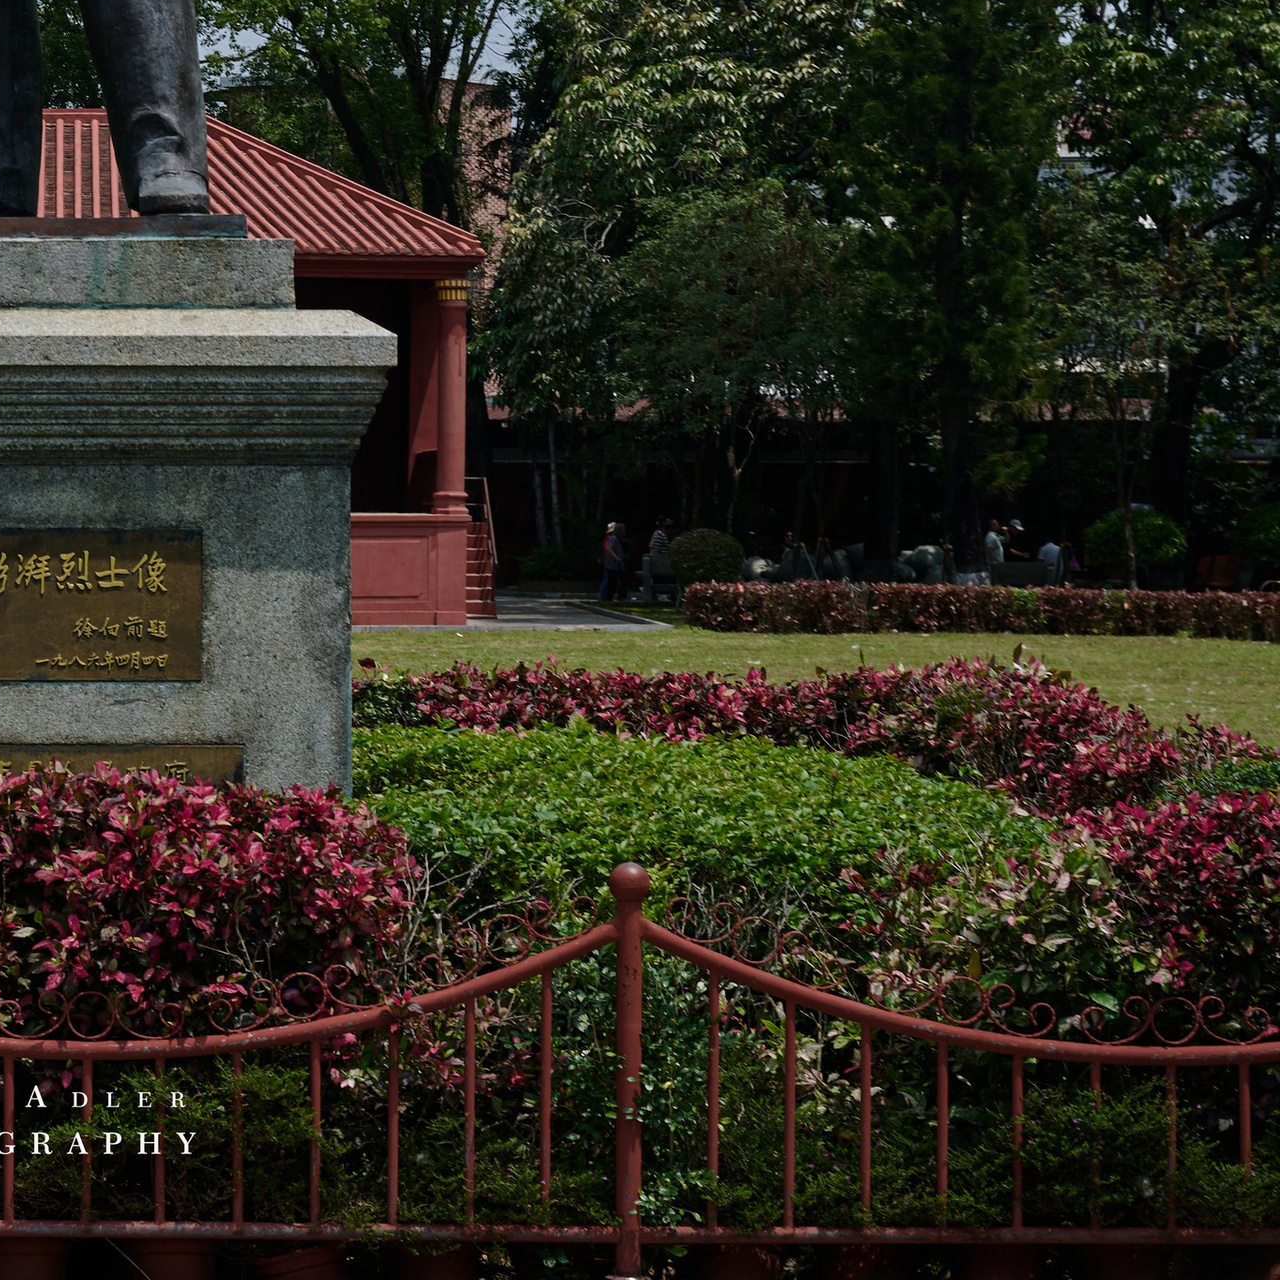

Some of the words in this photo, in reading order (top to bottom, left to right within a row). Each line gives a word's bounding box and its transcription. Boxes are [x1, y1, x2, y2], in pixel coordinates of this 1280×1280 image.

[35, 651, 169, 671] 一九八六年四月四日
